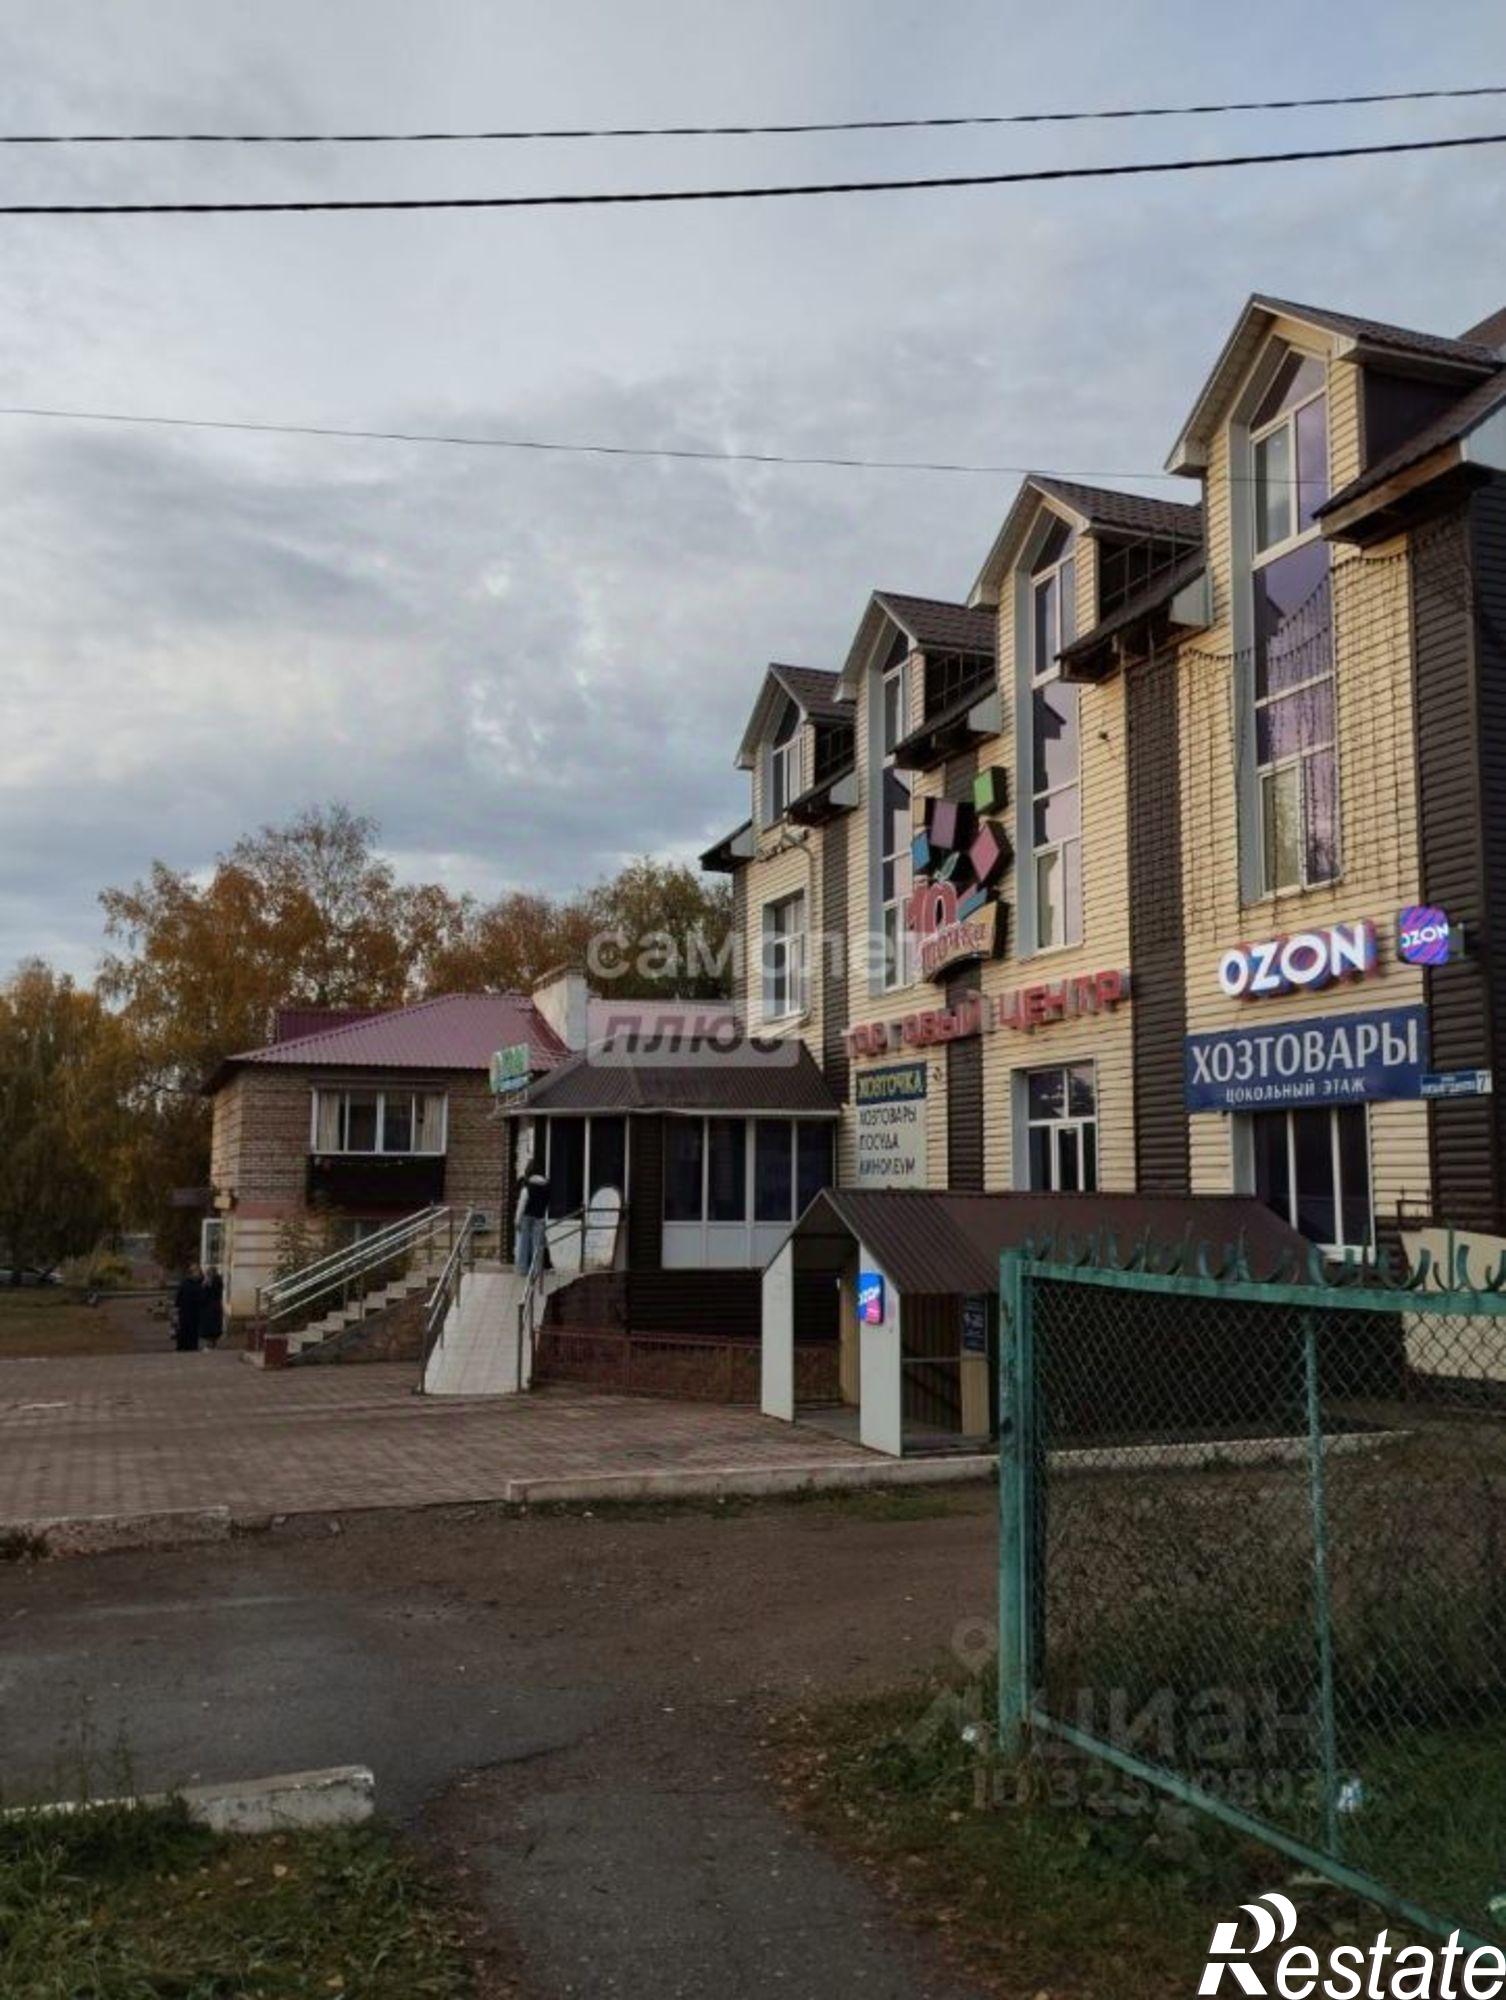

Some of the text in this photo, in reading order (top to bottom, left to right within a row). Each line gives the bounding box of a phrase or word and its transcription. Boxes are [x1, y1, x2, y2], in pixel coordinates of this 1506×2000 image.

[1218, 921, 1370, 998] OZON
[1401, 922, 1449, 948] OZON
[999, 970, 1124, 1033] ЦЕНТР
[1191, 1018, 1418, 1085] ХОЗТОВАРЫ
[1226, 1077, 1366, 1104] ЦОКОЛЬНЫЙ ЭТАЖ
